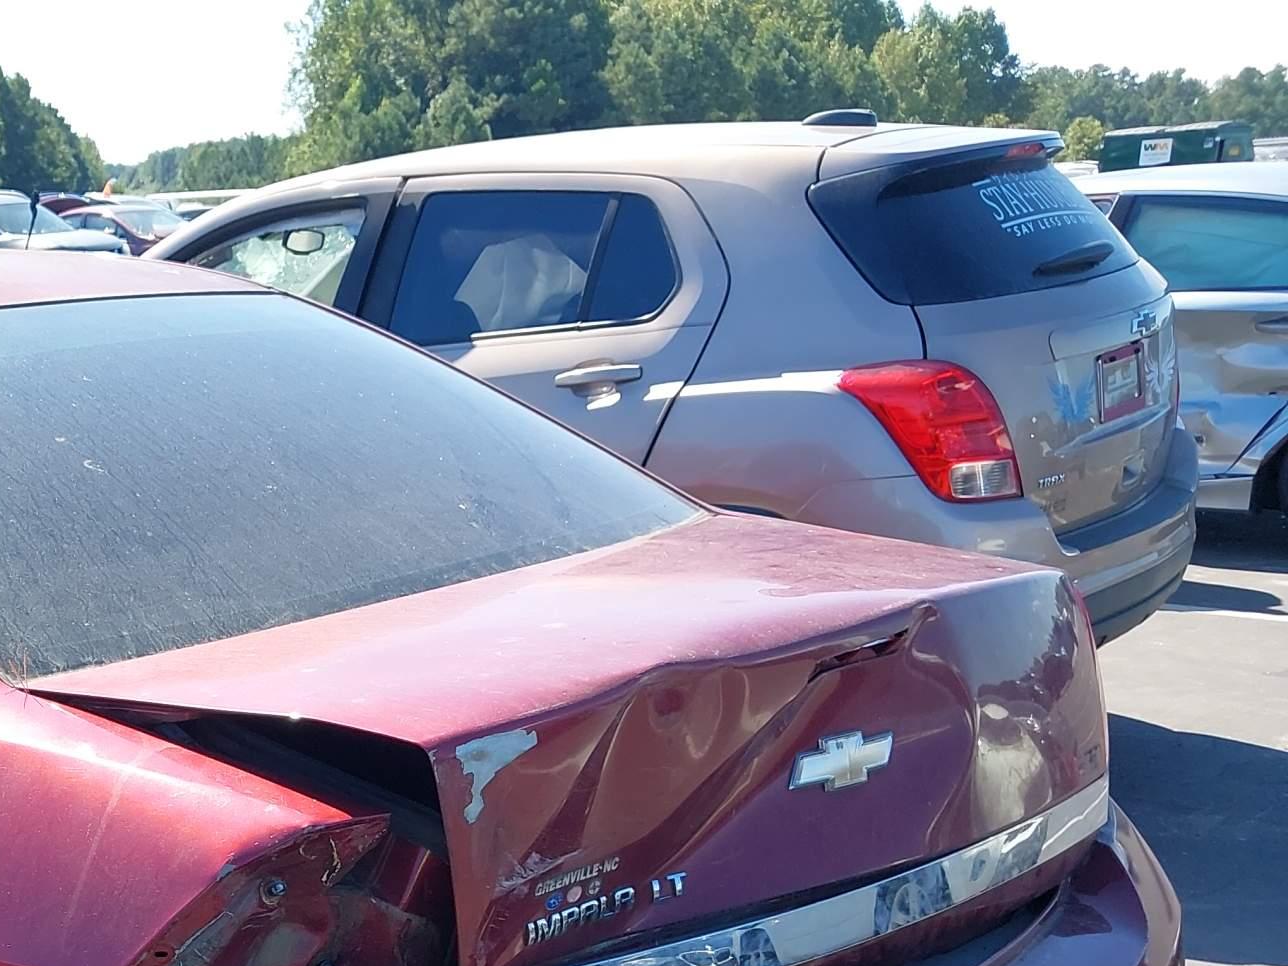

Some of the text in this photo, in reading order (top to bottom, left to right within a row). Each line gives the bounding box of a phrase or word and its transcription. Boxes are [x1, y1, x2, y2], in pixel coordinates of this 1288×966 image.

[1037, 215, 1062, 230] LESS
[1038, 472, 1065, 489] TRAX
[527, 872, 688, 945] IMPALA LT
